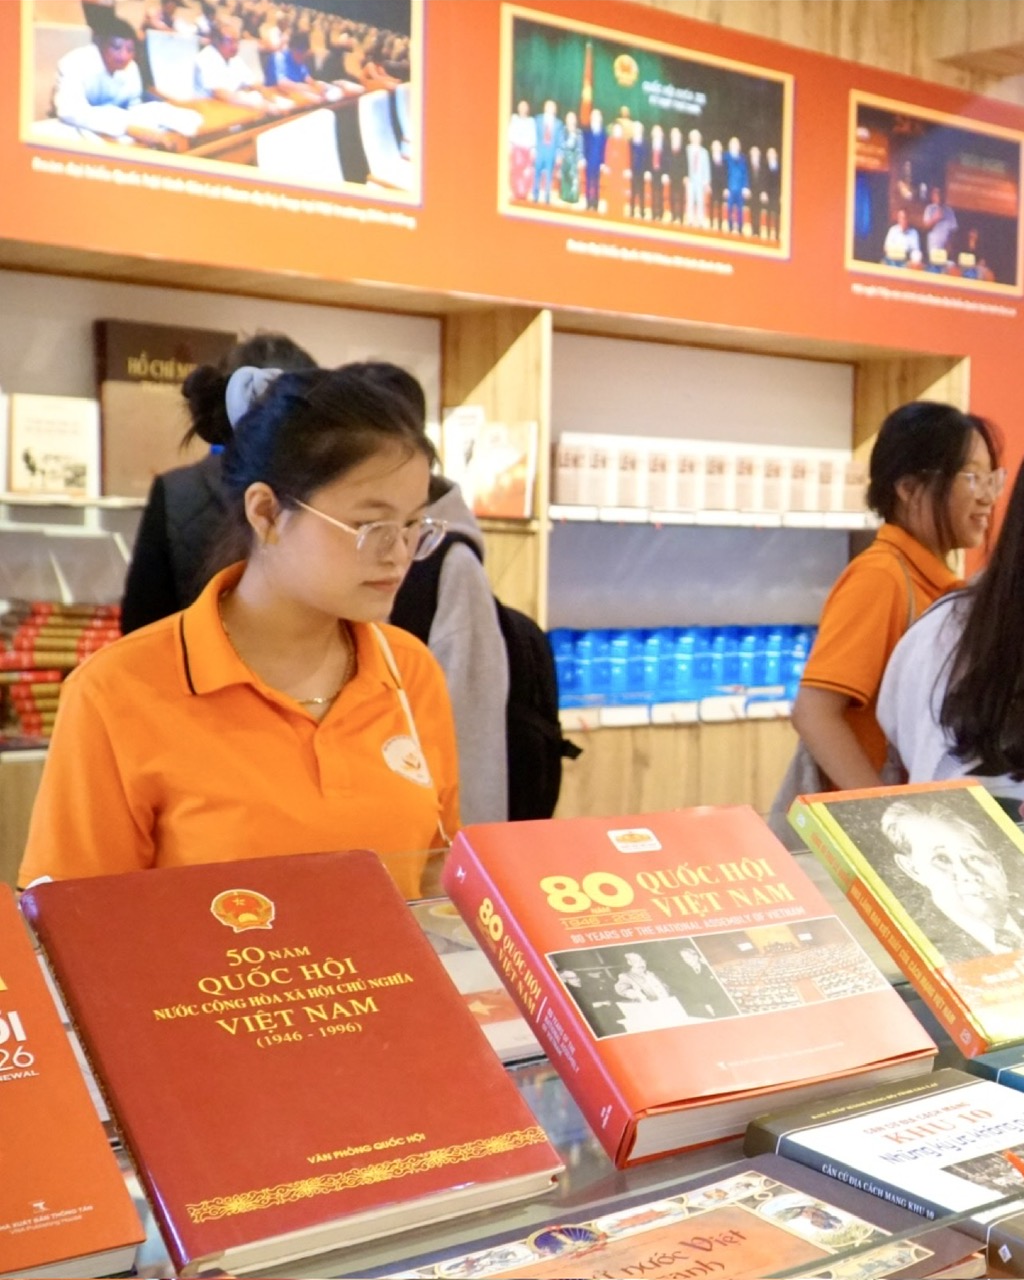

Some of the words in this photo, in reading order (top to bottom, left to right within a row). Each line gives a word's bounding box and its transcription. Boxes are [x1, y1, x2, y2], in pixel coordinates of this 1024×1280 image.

[126, 352, 149, 376] HỒ
[149, 356, 175, 379] CHÍ
[539, 871, 635, 914] 80
[635, 862, 720, 895] QUỐC
[719, 856, 777, 883] HỘI
[478, 897, 504, 942] 80
[650, 886, 732, 919] VIỆT
[733, 881, 797, 909] NAM
[585, 929, 621, 944] YEARS
[620, 927, 634, 939] OF
[636, 924, 655, 937] THE
[654, 920, 702, 936] NATIONAL
[752, 911, 766, 924] OF
[765, 906, 807, 921] VIETNAM
[225, 946, 266, 968] 50
[267, 945, 312, 962] NĂM
[502, 934, 527, 976] QUỐC
[524, 969, 543, 1001] HỘI
[197, 965, 293, 997] QUỐC
[298, 956, 358, 981] HỘI
[497, 947, 518, 985] VIỆT
[517, 981, 537, 1016] NAM
[153, 1002, 200, 1021] NƯỚC
[201, 997, 246, 1015] CỘNG
[247, 991, 283, 1008] HÒA
[282, 987, 307, 1003] XÃ
[306, 984, 336, 1000] HỘI
[336, 977, 368, 994] CHỦ
[367, 972, 414, 990] NGHĨA
[215, 1008, 296, 1036] VIỆT
[301, 996, 380, 1023] NAM
[256, 1029, 303, 1050] (1946
[318, 1021, 363, 1039] 1996)
[884, 1118, 956, 1145] KHU
[957, 1107, 993, 1125] 10
[306, 1152, 333, 1165] VĂN
[332, 1144, 373, 1160] PHÒNG
[373, 1136, 406, 1151] QUỐC
[405, 1131, 426, 1144] HỘI
[821, 1163, 838, 1179] CĂN
[849, 1176, 863, 1190] ĐỊA
[863, 1180, 885, 1199] CÁCH
[907, 1200, 926, 1216] KHU
[925, 1208, 936, 1220] 10
